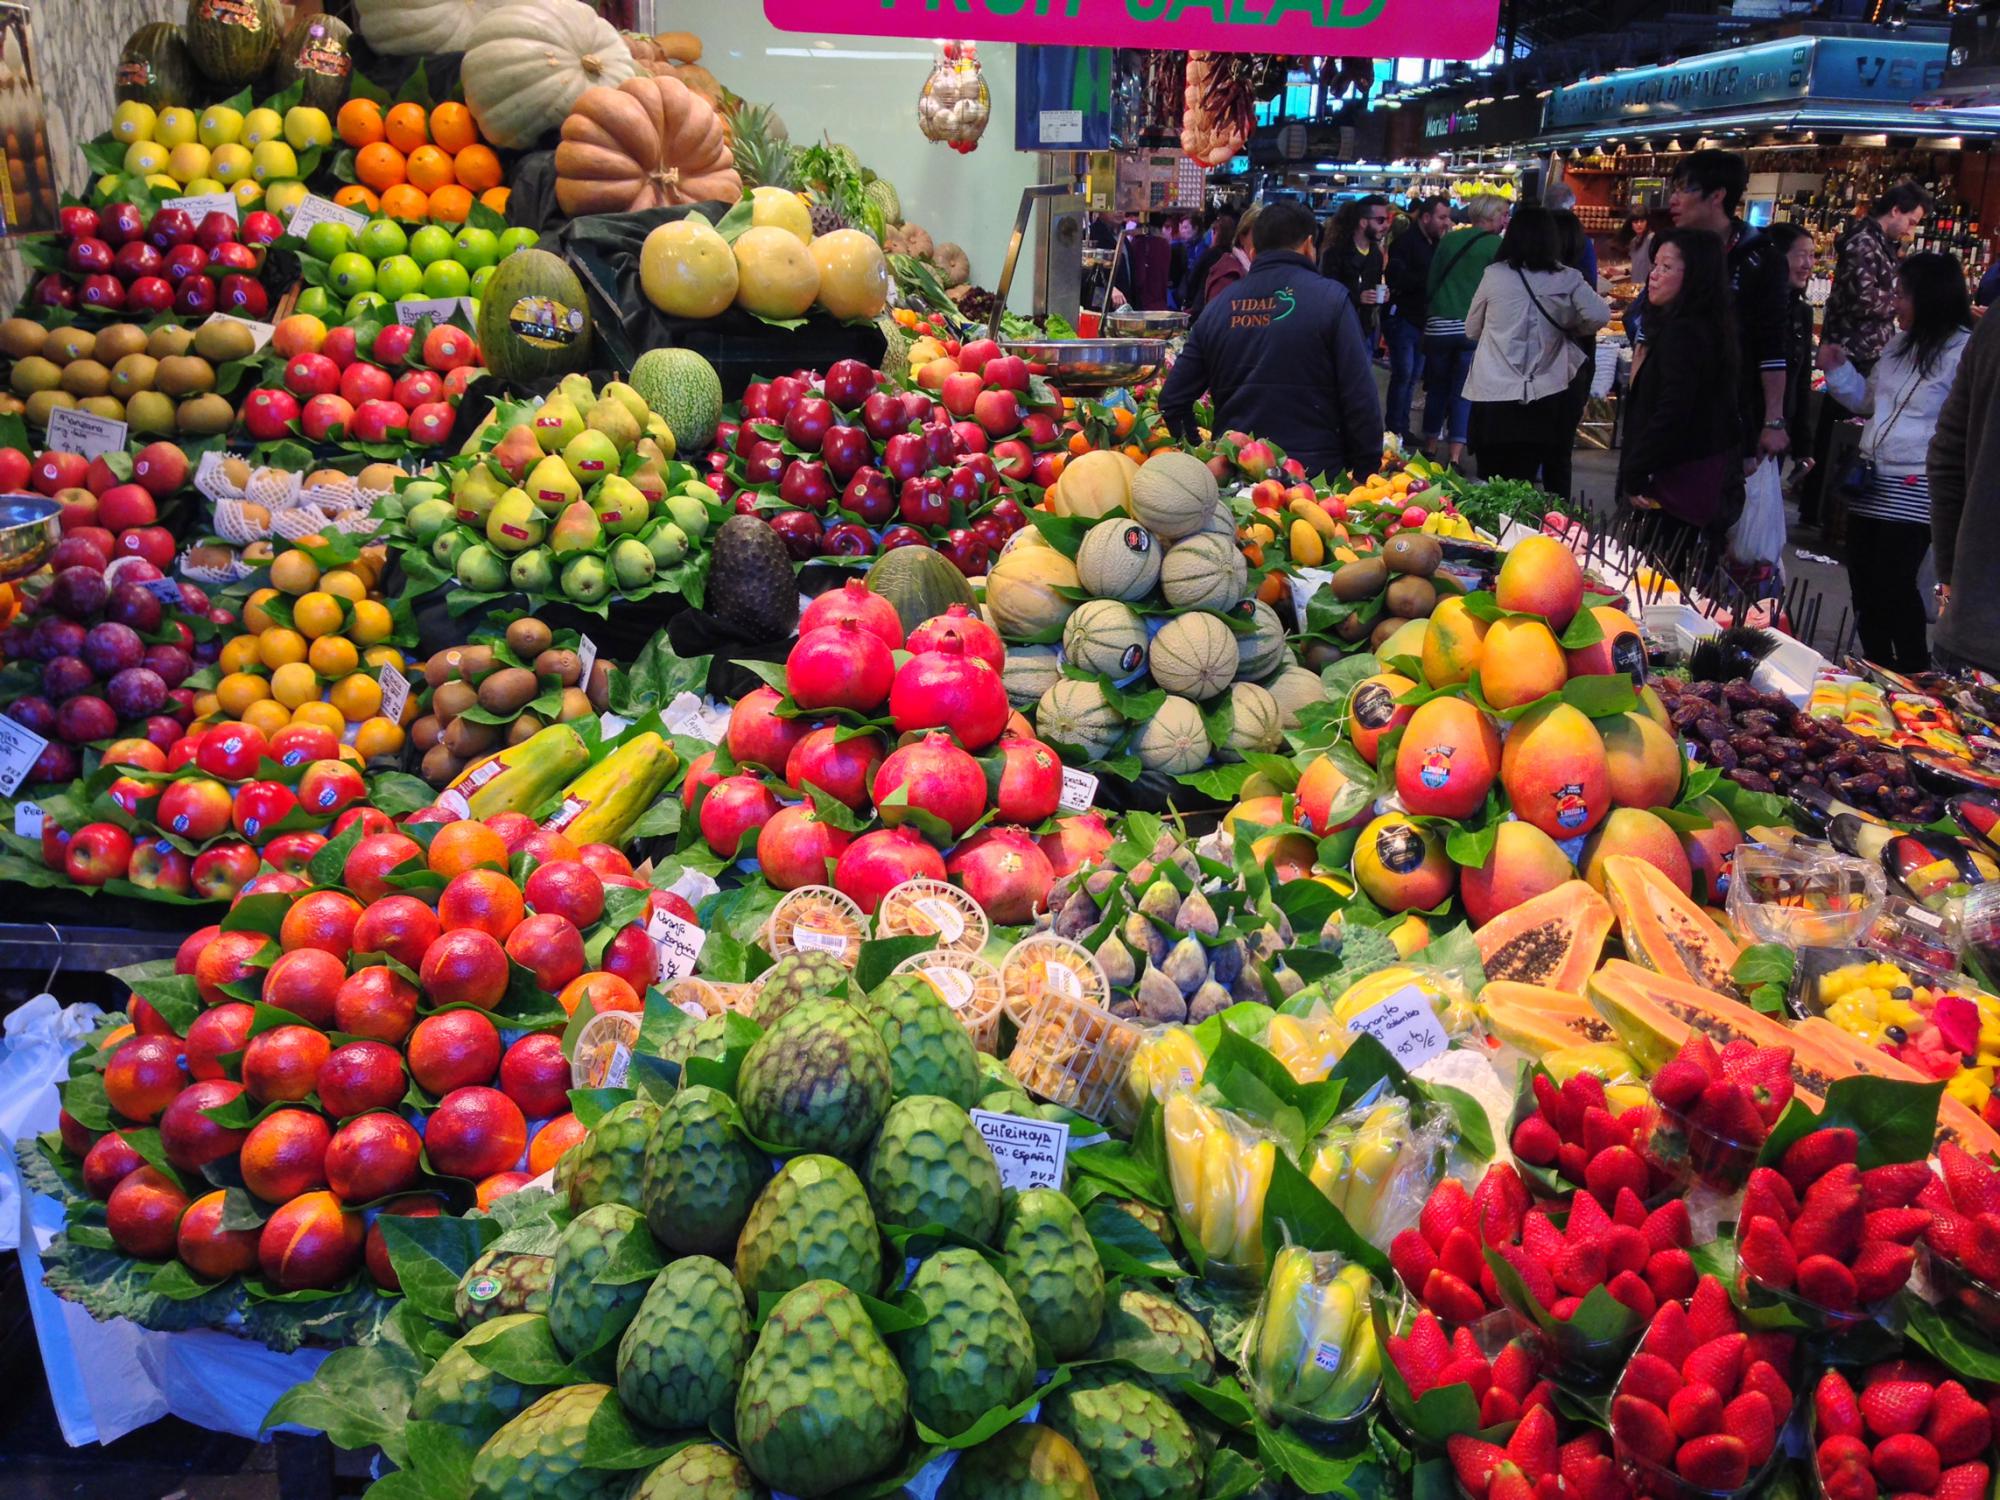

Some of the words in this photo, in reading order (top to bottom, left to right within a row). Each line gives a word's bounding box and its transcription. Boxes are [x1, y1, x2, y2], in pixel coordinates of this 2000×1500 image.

[1231, 297, 1277, 311] VIDAL
[1231, 313, 1271, 328] PONS
[981, 1122, 1053, 1148] CHIRIMOYA
